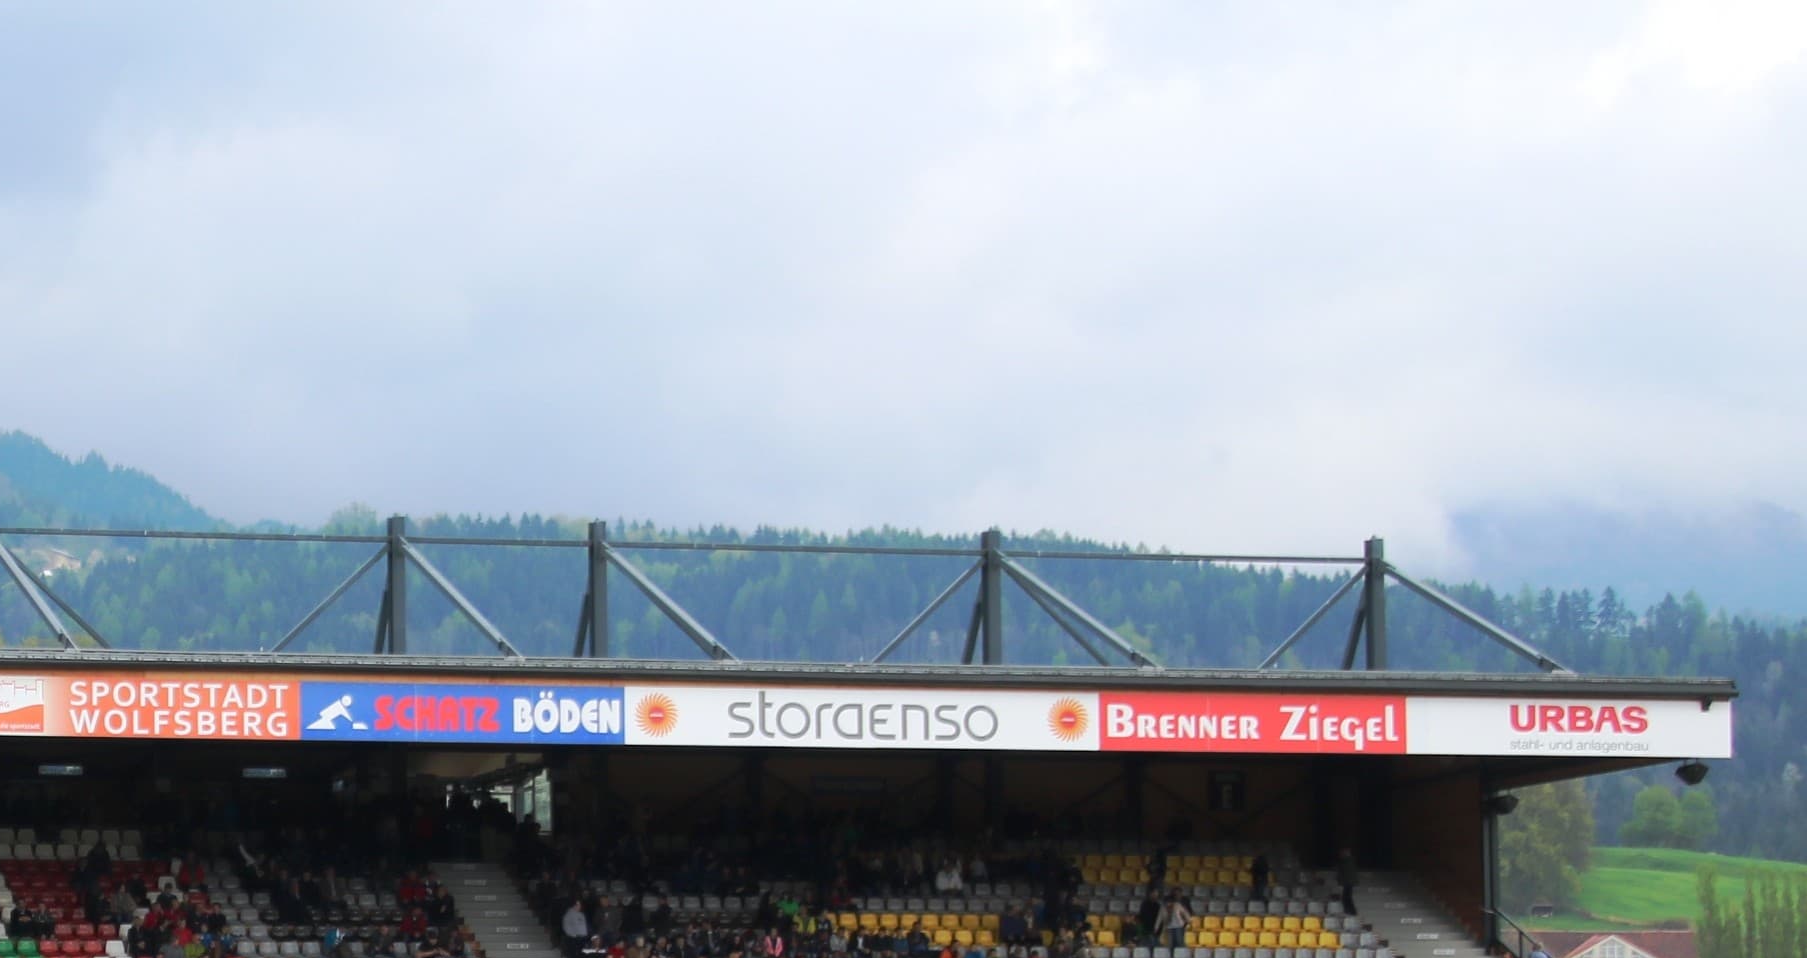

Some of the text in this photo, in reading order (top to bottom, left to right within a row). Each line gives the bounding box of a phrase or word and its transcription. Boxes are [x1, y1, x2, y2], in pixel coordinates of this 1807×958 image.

[69, 681, 289, 709] SPORTSTADT
[69, 709, 289, 738] WOLFSBERG
[372, 691, 620, 735] SCHATZ BÖDEN
[1509, 705, 1648, 734] URBAS
[1510, 739, 1649, 755] stahl- und anlagenbau
